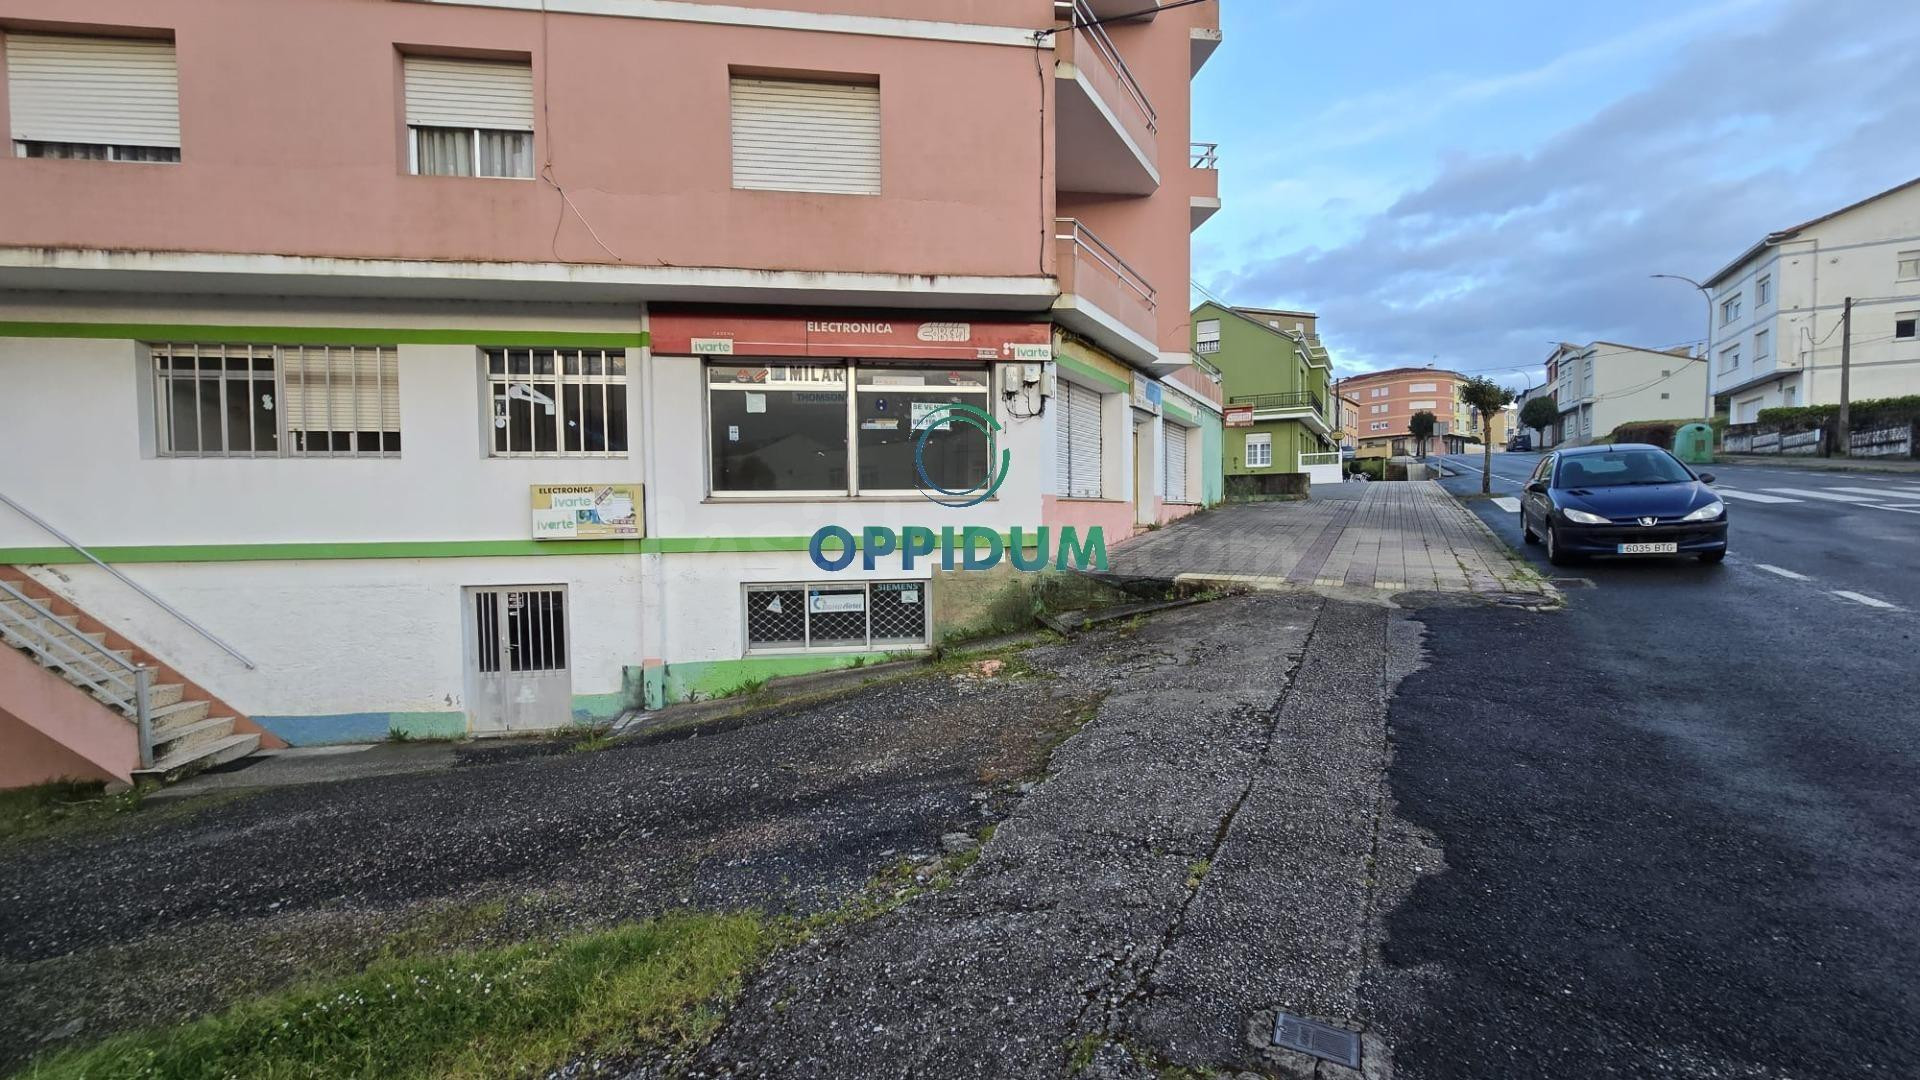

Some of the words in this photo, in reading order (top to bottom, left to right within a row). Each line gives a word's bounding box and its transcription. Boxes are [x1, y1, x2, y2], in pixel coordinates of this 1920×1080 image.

[807, 321, 893, 334] ELECTRONICA
[694, 341, 730, 352] ivarte
[1017, 345, 1049, 358] ivarte
[789, 365, 844, 382] MILAR
[797, 393, 845, 402] THOMSON
[539, 486, 594, 494] ELECTRONICA
[554, 494, 592, 507] ivarte
[537, 519, 574, 530] ivarte
[1625, 544, 1651, 552] 6035
[1654, 543, 1673, 552] BTG
[877, 583, 919, 592] SIEMENS
